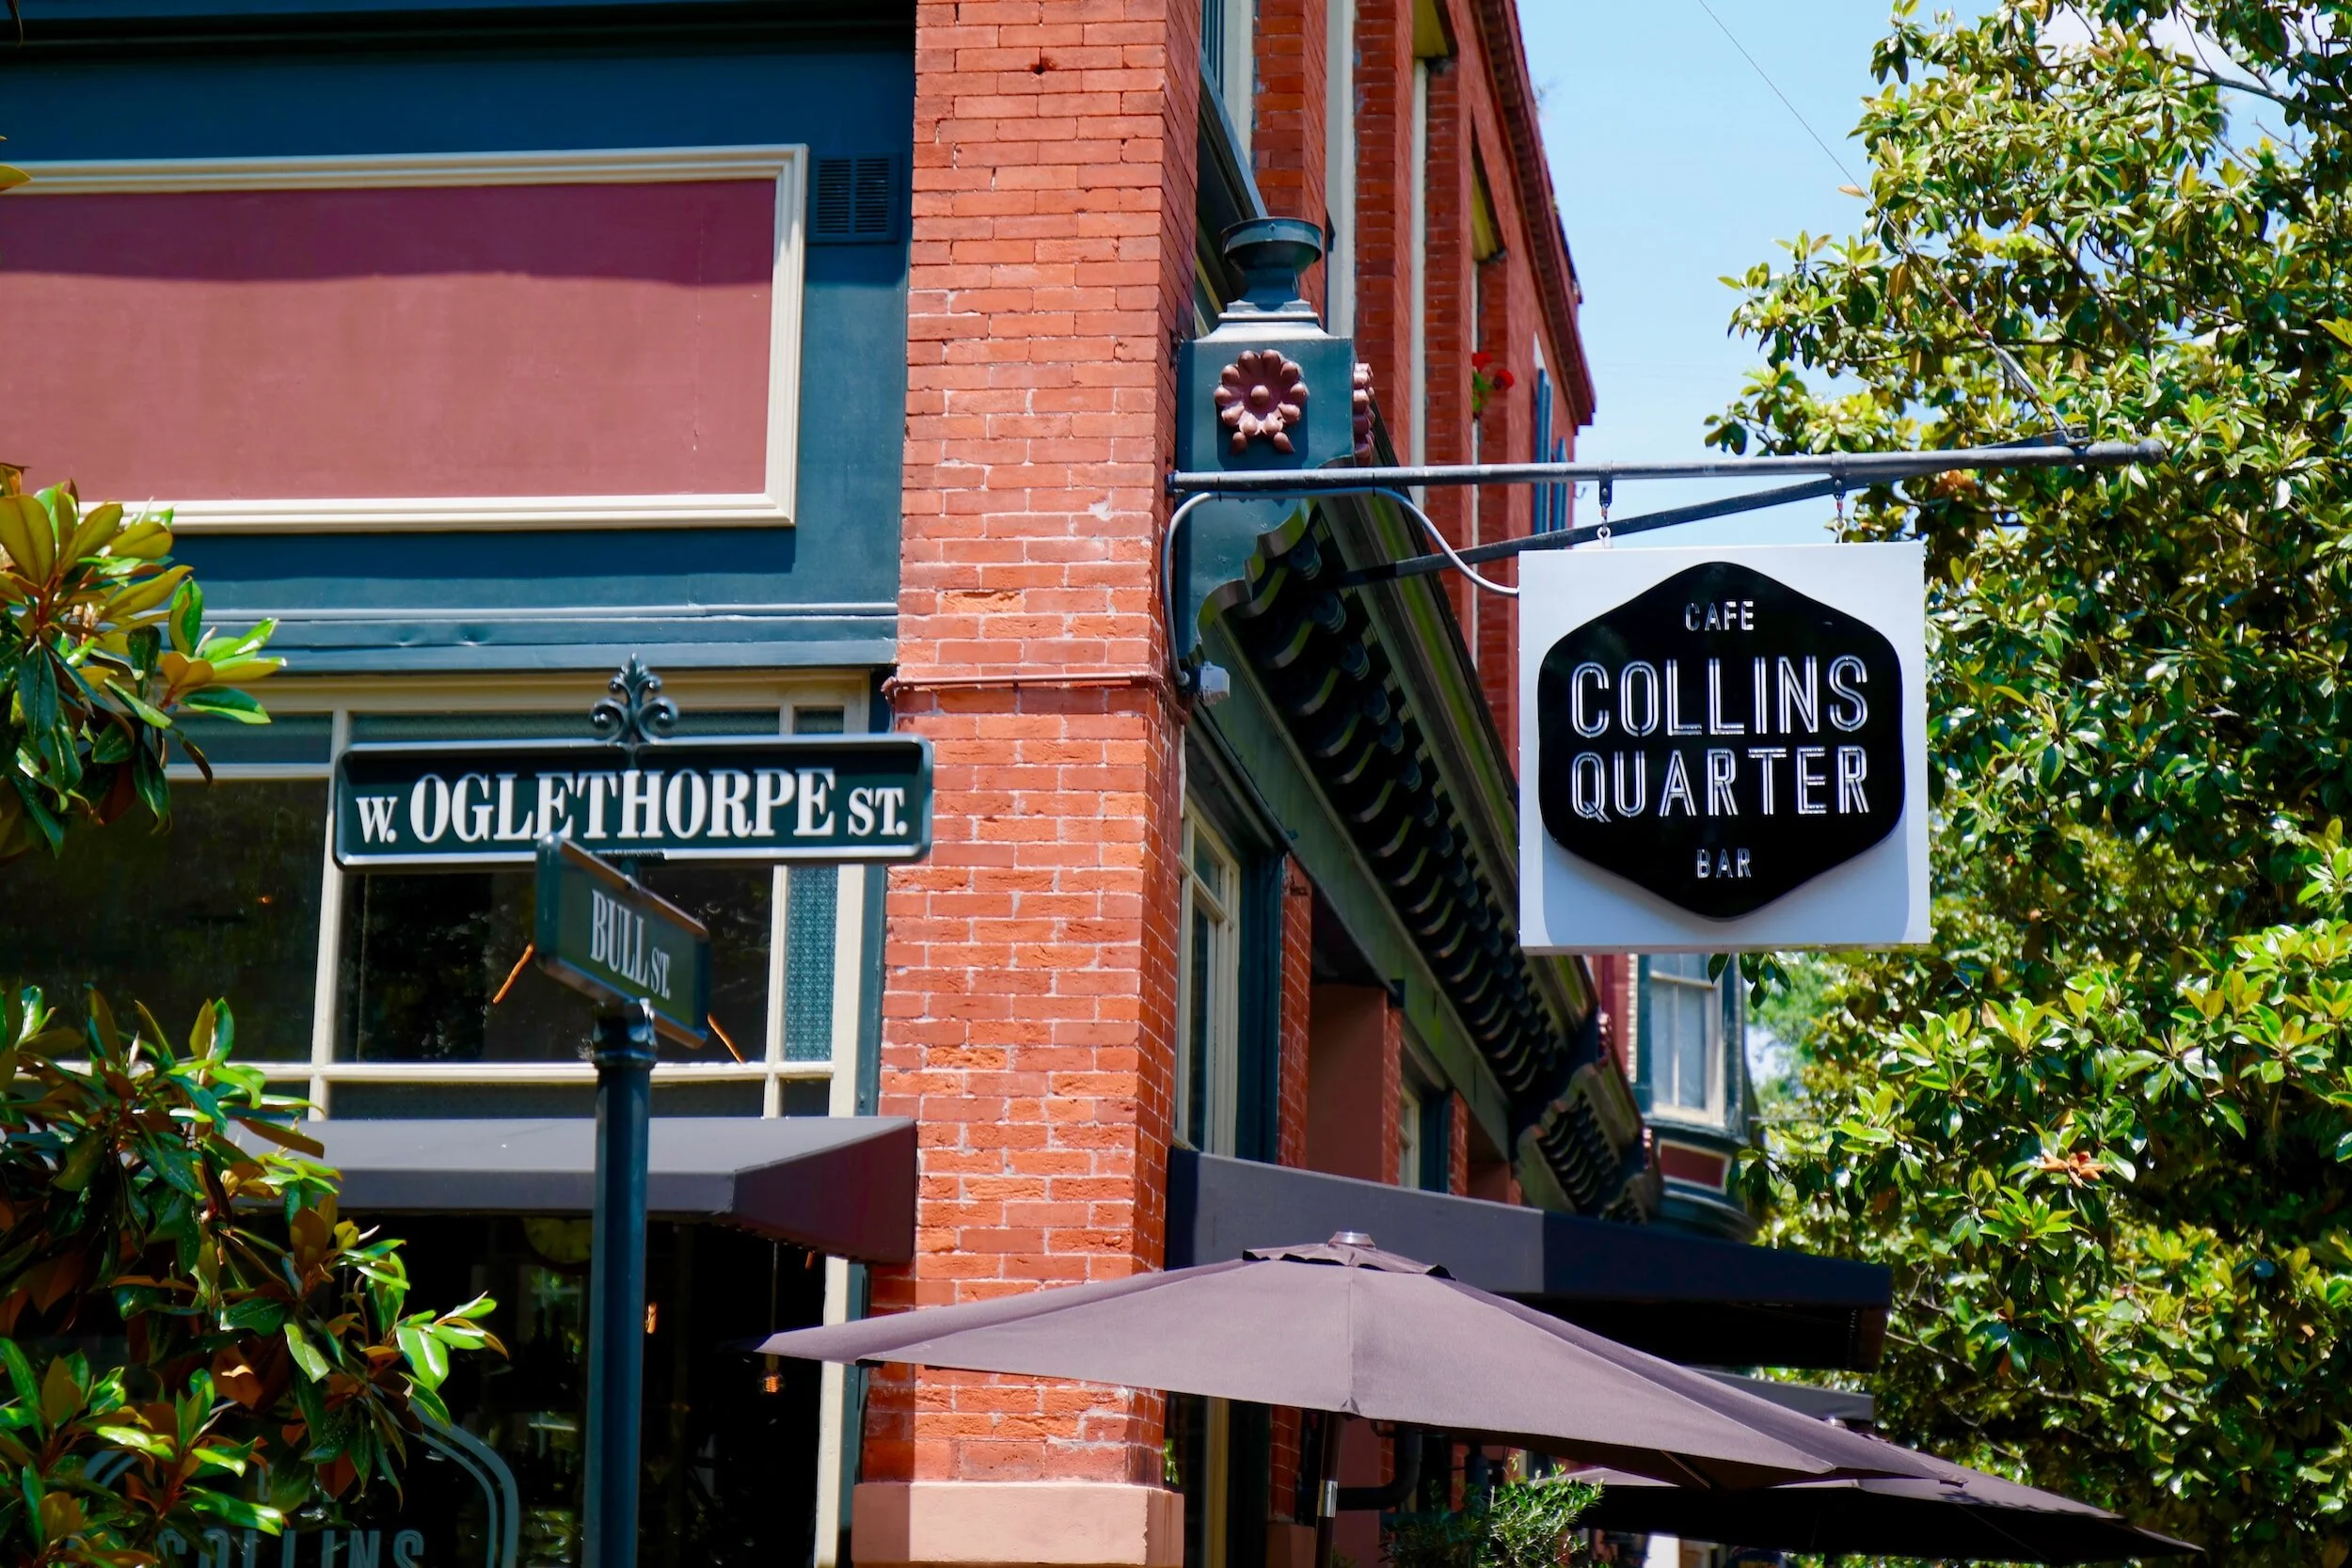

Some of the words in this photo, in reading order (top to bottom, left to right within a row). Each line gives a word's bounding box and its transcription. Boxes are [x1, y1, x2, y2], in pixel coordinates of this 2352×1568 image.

[1685, 600, 1755, 631] CAFE
[1570, 655, 1869, 738] COLLINS
[356, 796, 398, 844] W.
[409, 768, 836, 844] OGLETHORPE
[847, 787, 909, 838] ST.
[1570, 745, 1870, 823] QUARTER
[1696, 848, 1752, 879] BAR
[590, 888, 648, 988] BULL
[650, 946, 671, 1000] ST.
